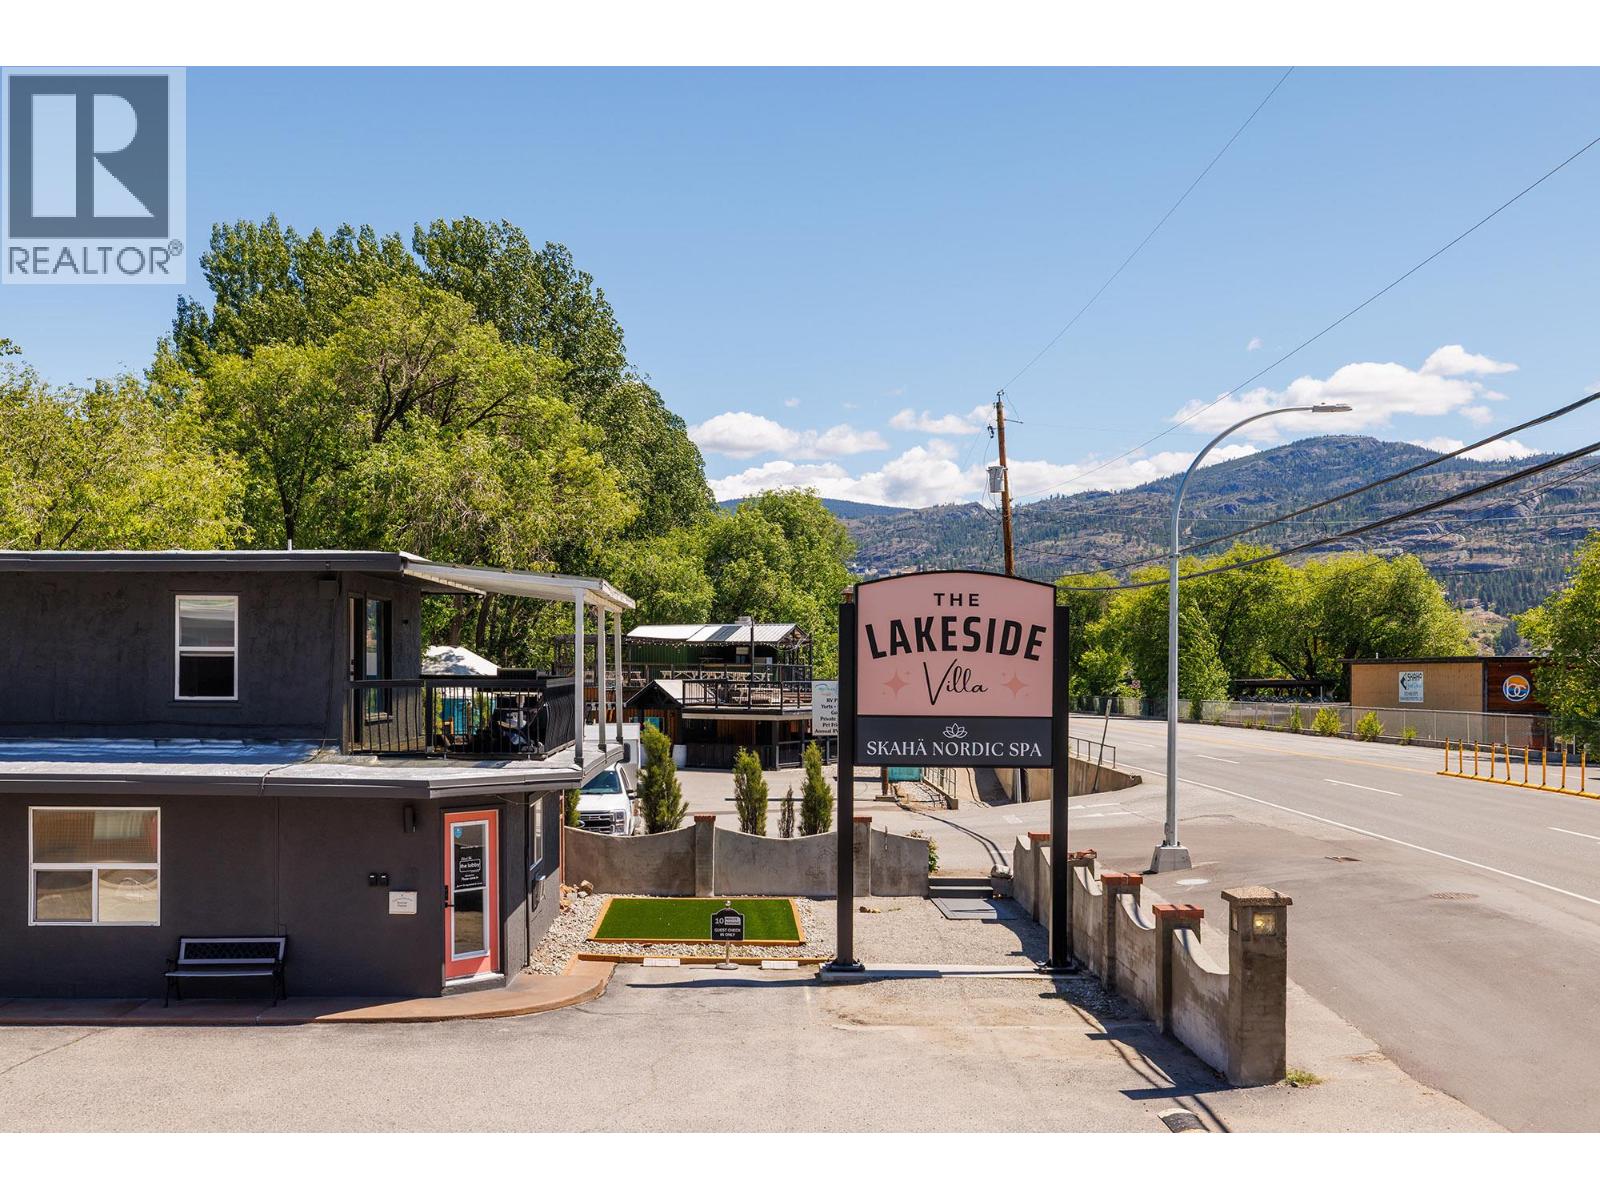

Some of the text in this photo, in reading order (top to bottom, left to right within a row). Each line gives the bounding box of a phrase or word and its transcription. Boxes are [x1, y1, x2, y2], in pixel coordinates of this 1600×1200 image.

[933, 593, 980, 607] THE
[865, 615, 1047, 661] LAKESIDE
[923, 658, 988, 706] Villa
[866, 738, 1042, 758] SKAHÄ NORDIC SPA
